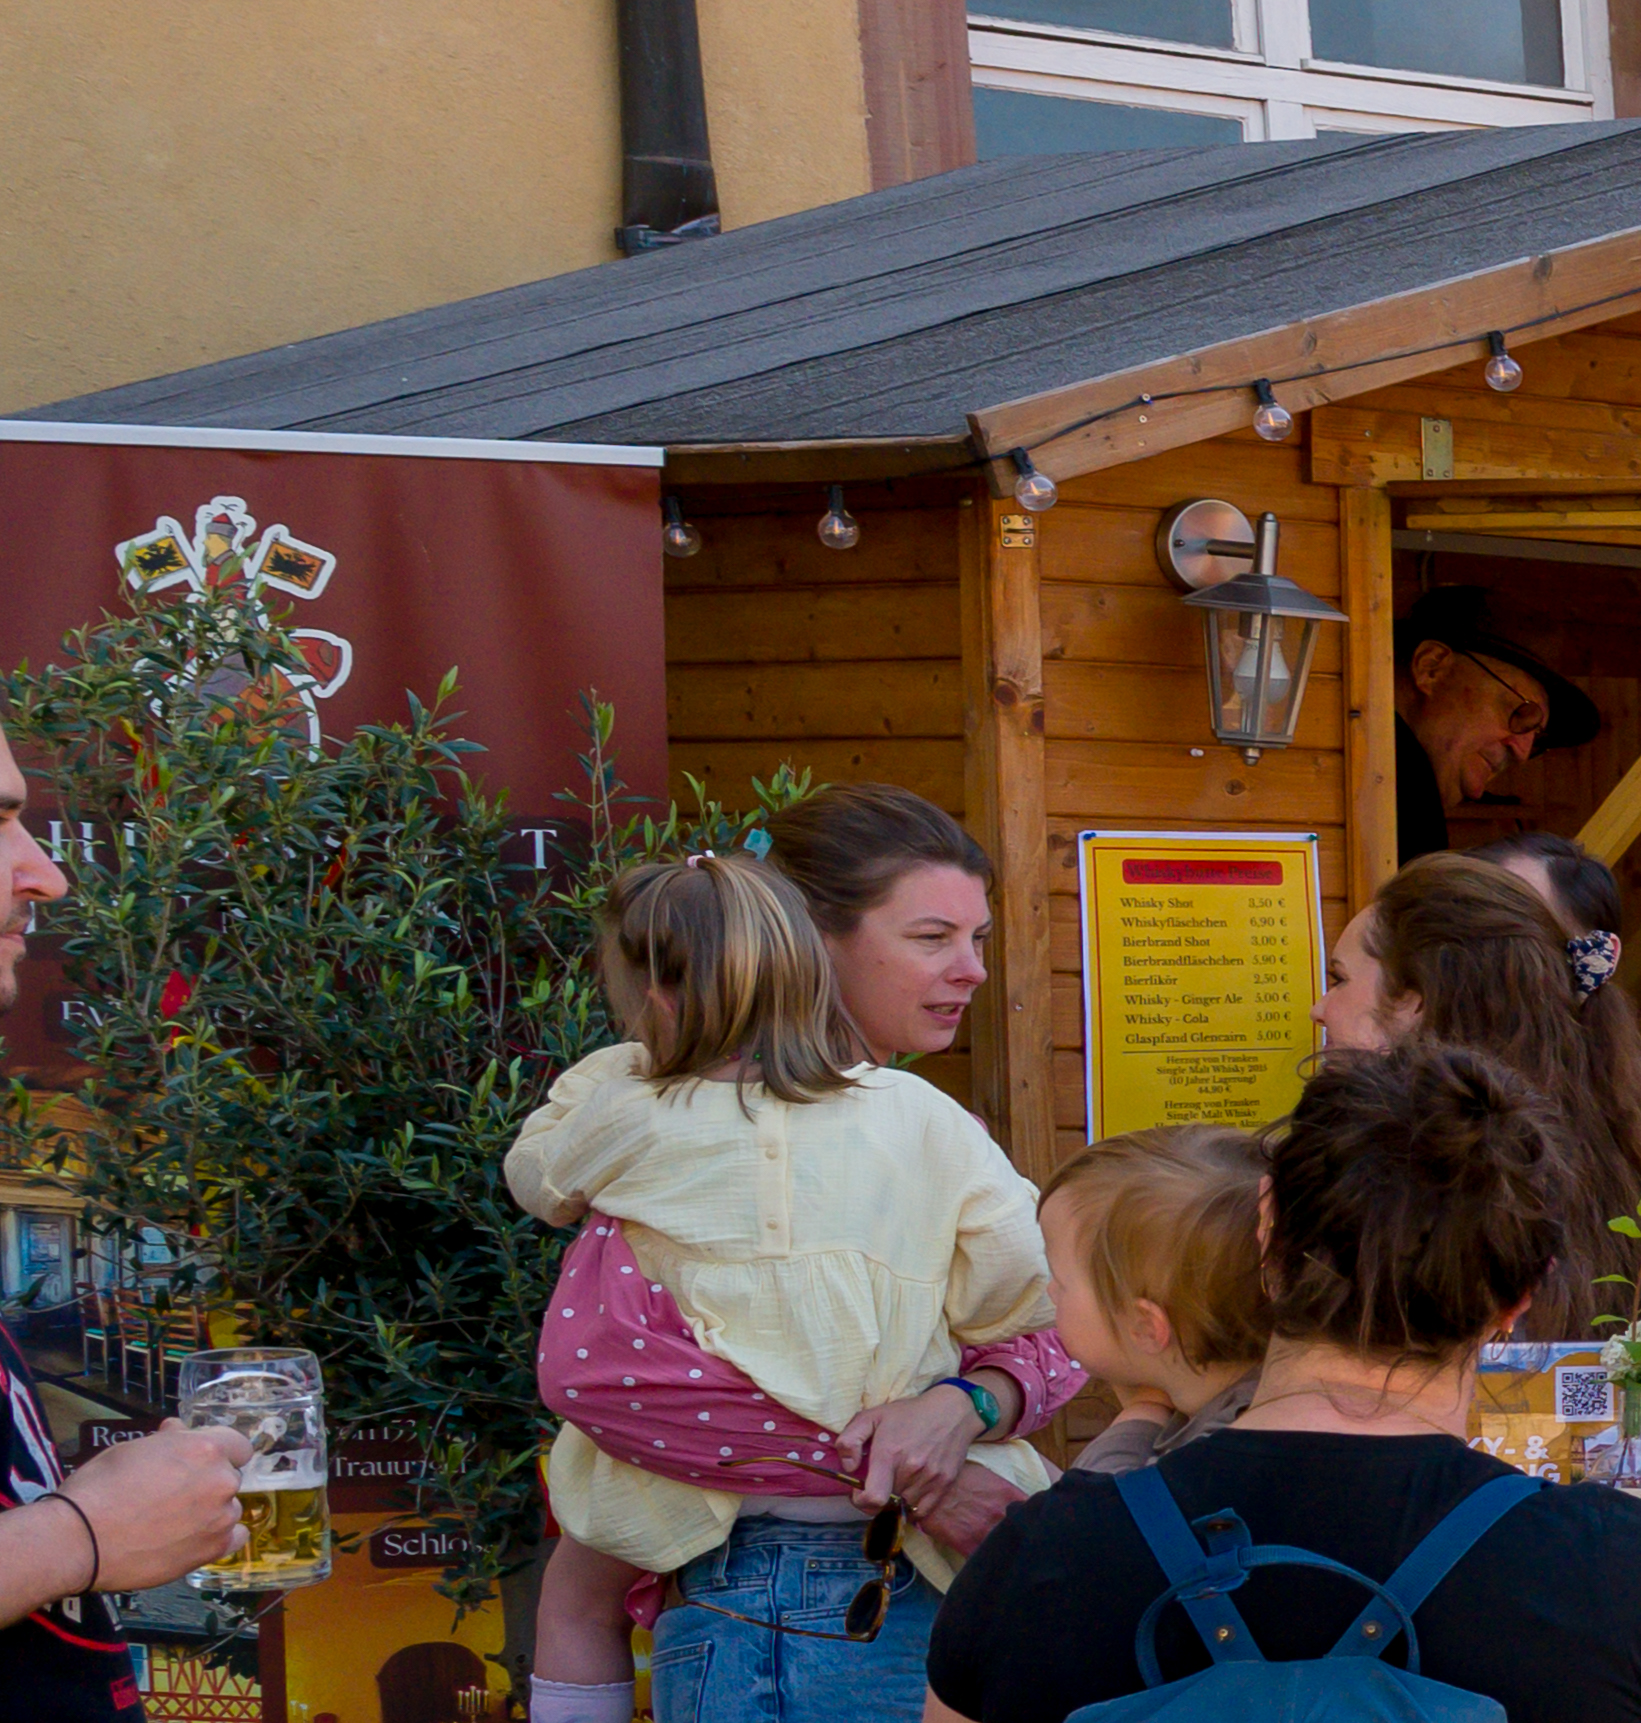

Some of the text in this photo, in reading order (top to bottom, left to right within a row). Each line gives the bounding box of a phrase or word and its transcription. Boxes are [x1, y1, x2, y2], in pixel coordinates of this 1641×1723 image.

[1119, 897, 1164, 911] Whisky
[1167, 898, 1194, 909] Shot
[1120, 917, 1228, 931] Whiskyfläschchen
[1250, 917, 1275, 928] 6,90
[1122, 936, 1182, 947] Bierbrand
[1184, 936, 1210, 947] Shot
[1251, 936, 1276, 946] 3,00
[1123, 955, 1245, 967] Bierbrandfläschchen
[1252, 954, 1276, 965] 5,90
[1124, 975, 1178, 986] Bierlikör
[1253, 973, 1277, 984] 2,50
[1125, 994, 1171, 1008] Whisky
[1182, 993, 1220, 1007] Ginger
[1224, 993, 1243, 1004] Ale
[1125, 1013, 1172, 1027] Whisky
[1182, 1013, 1209, 1024] Cola
[1125, 1033, 1187, 1046] Glaspfand
[1190, 1032, 1247, 1042] Glencairn
